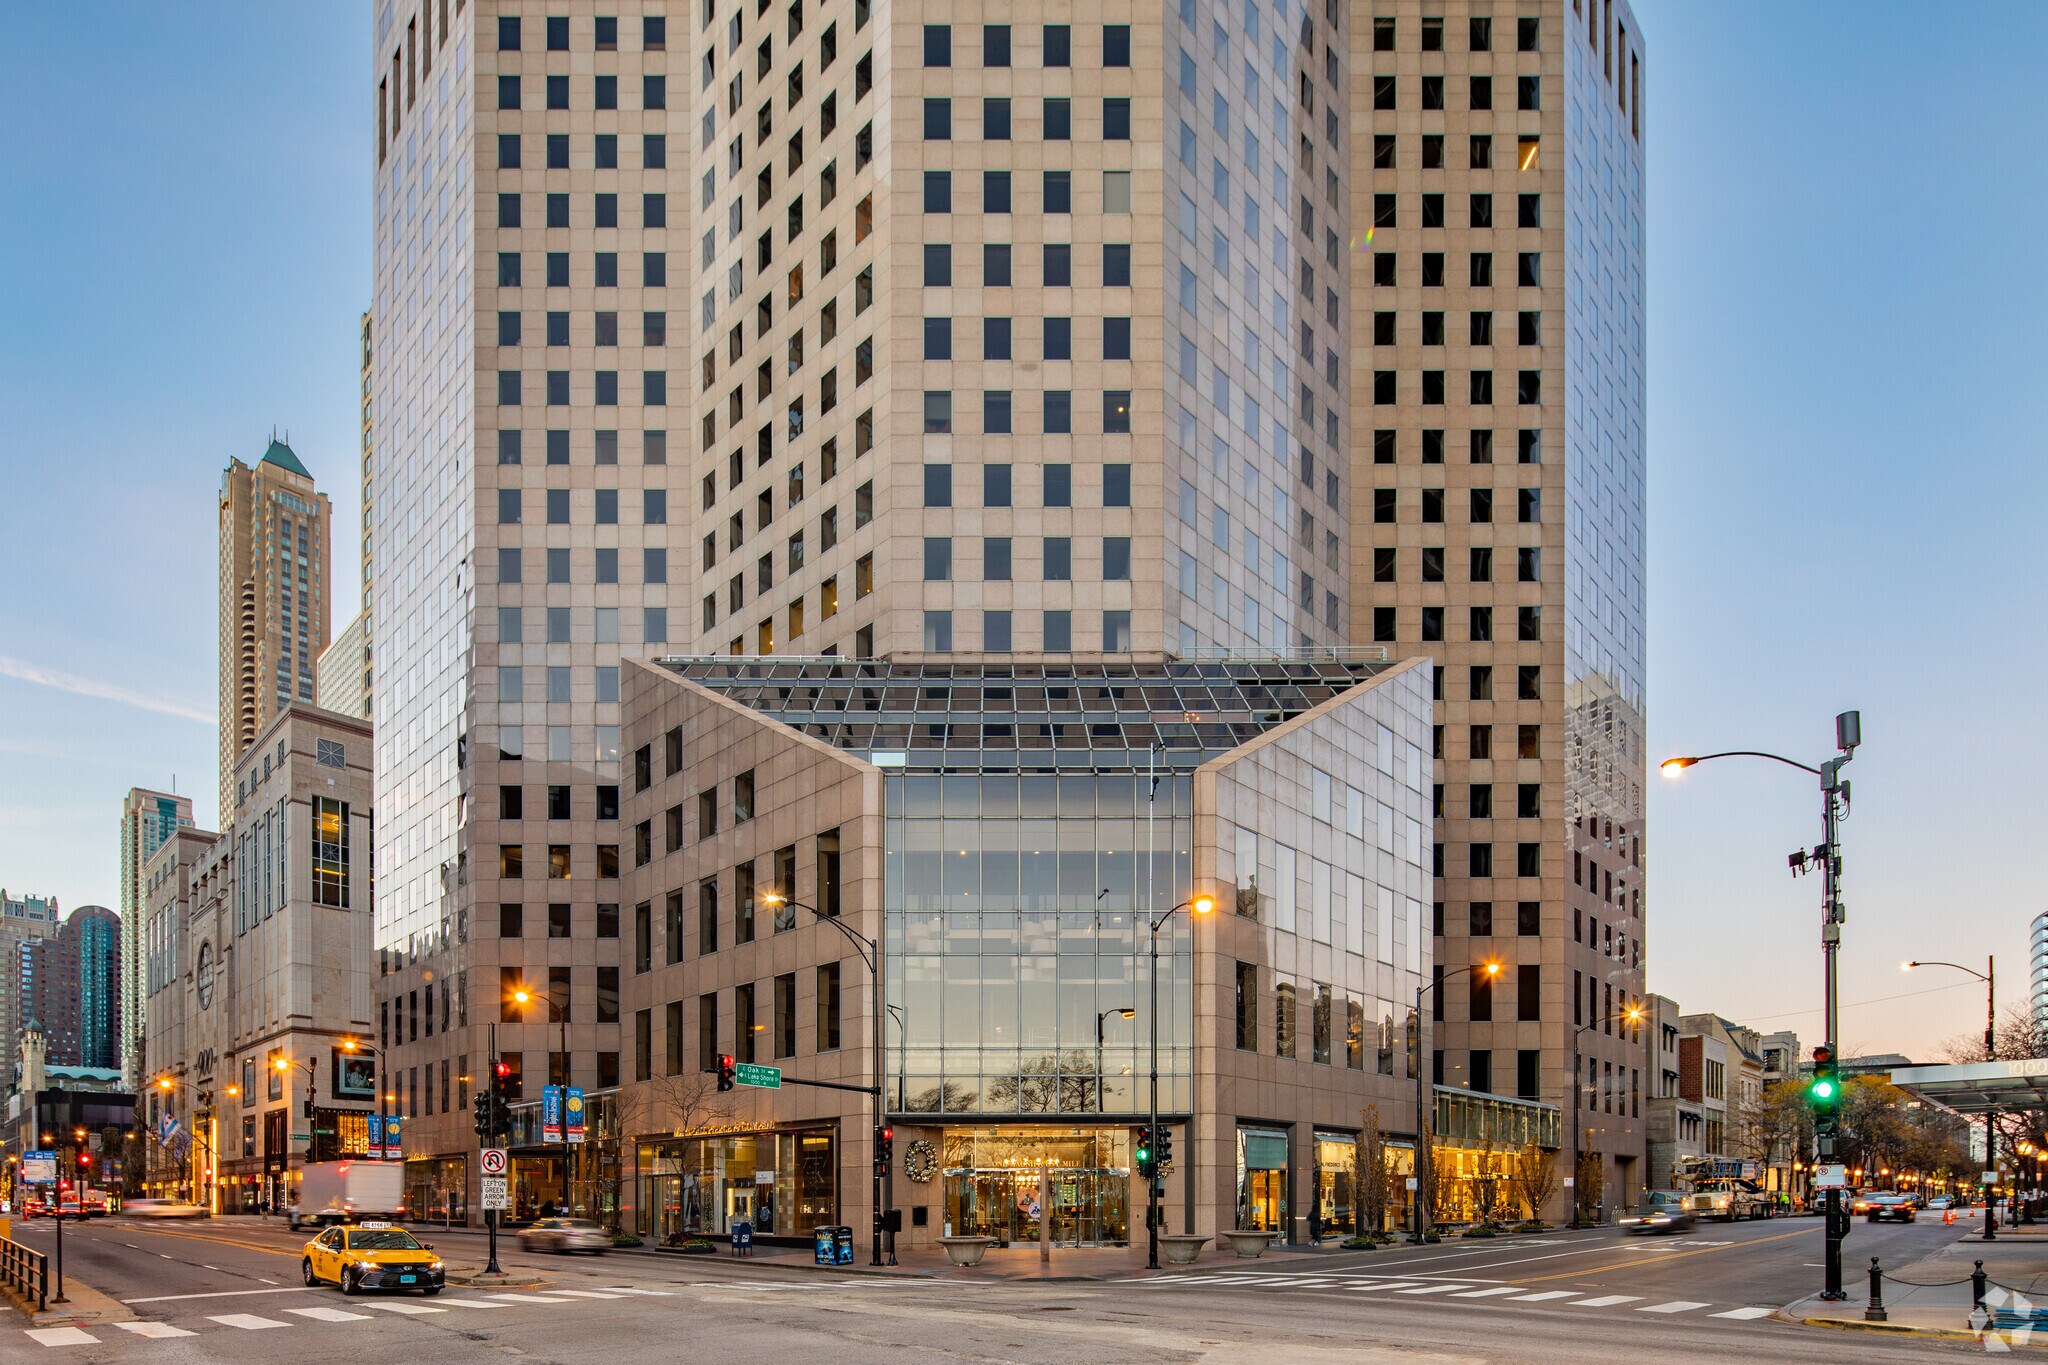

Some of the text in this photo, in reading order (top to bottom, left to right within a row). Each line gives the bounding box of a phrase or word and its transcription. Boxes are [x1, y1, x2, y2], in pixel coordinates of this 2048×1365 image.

[198, 1047, 213, 1080] 900
[747, 1066, 760, 1074] Oak
[2009, 1061, 2047, 1075] 1000
[760, 1074, 774, 1082] Shore
[1062, 1160, 1081, 1168] MILE
[817, 1233, 833, 1241] MAGIC
